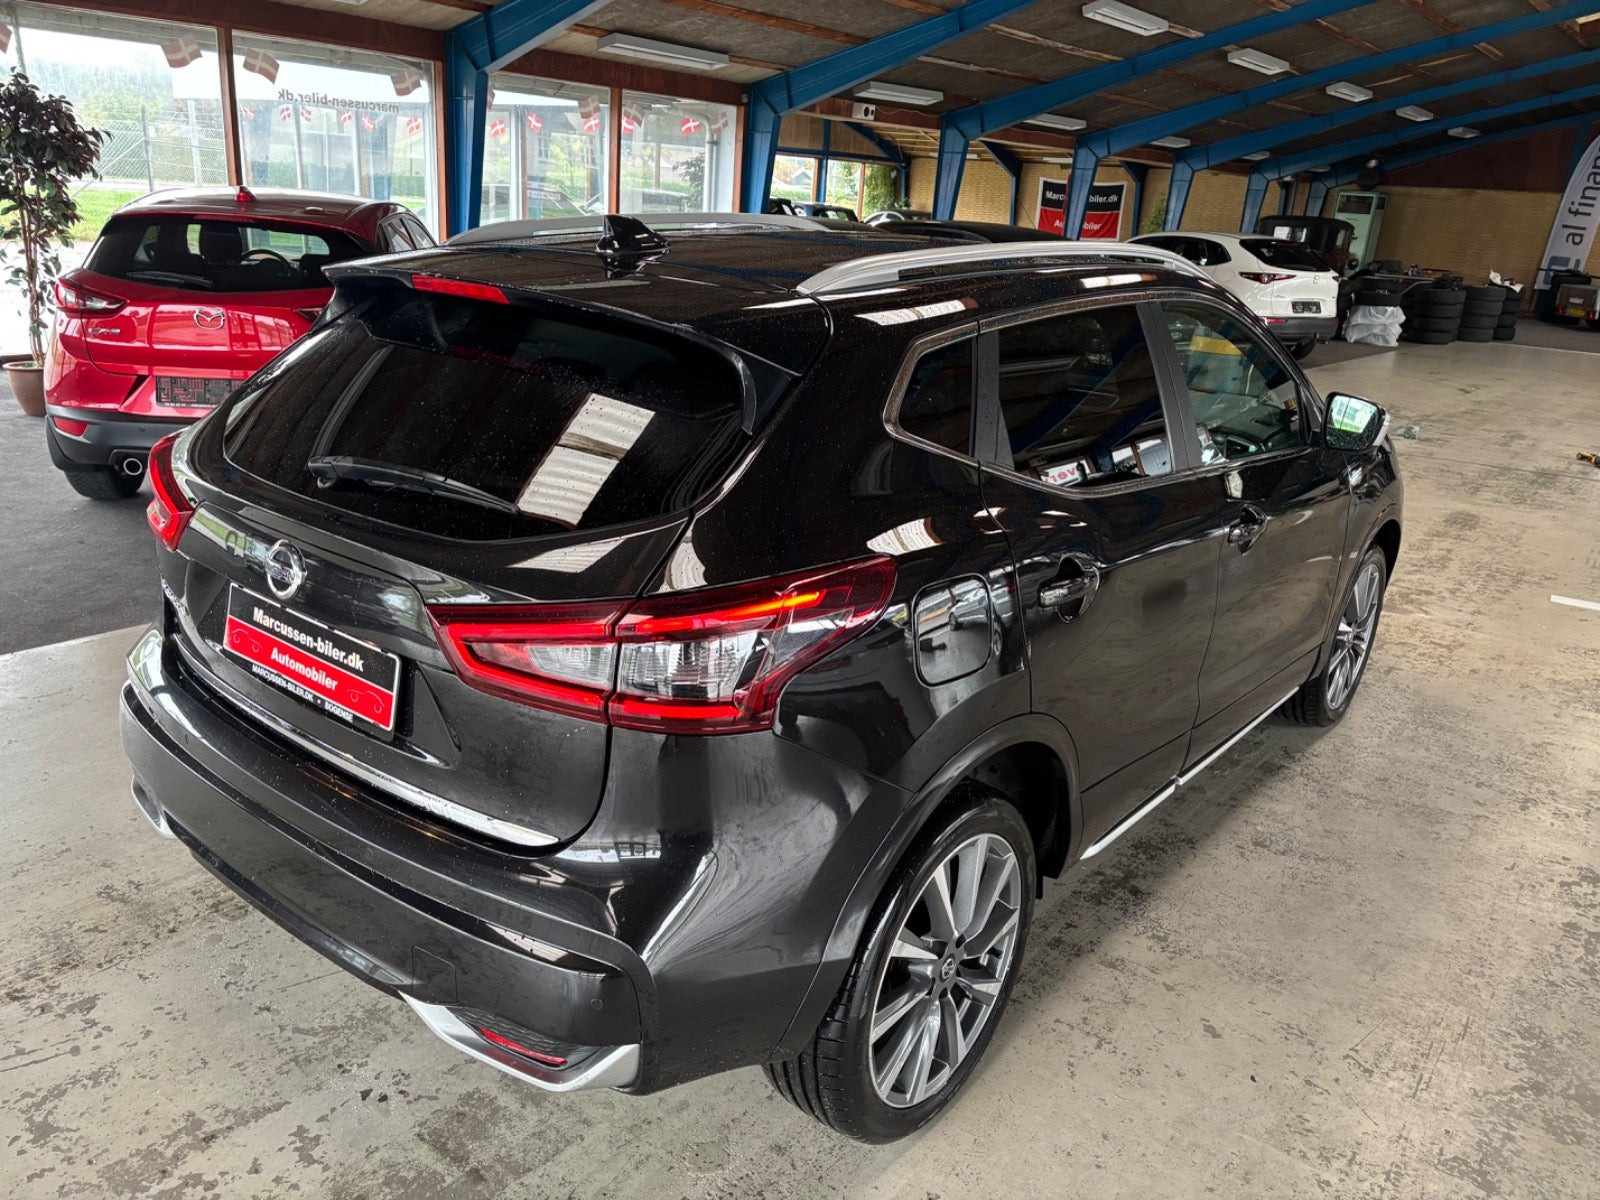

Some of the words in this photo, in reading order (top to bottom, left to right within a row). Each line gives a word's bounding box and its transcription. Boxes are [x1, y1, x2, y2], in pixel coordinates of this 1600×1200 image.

[1562, 223, 1587, 246] al
[253, 606, 364, 672] Marcussen-biler.dk
[252, 663, 314, 702] MARCUSSEN-BILER.DK
[324, 702, 354, 722] BOGENSE
[271, 647, 338, 691] Automobiler
